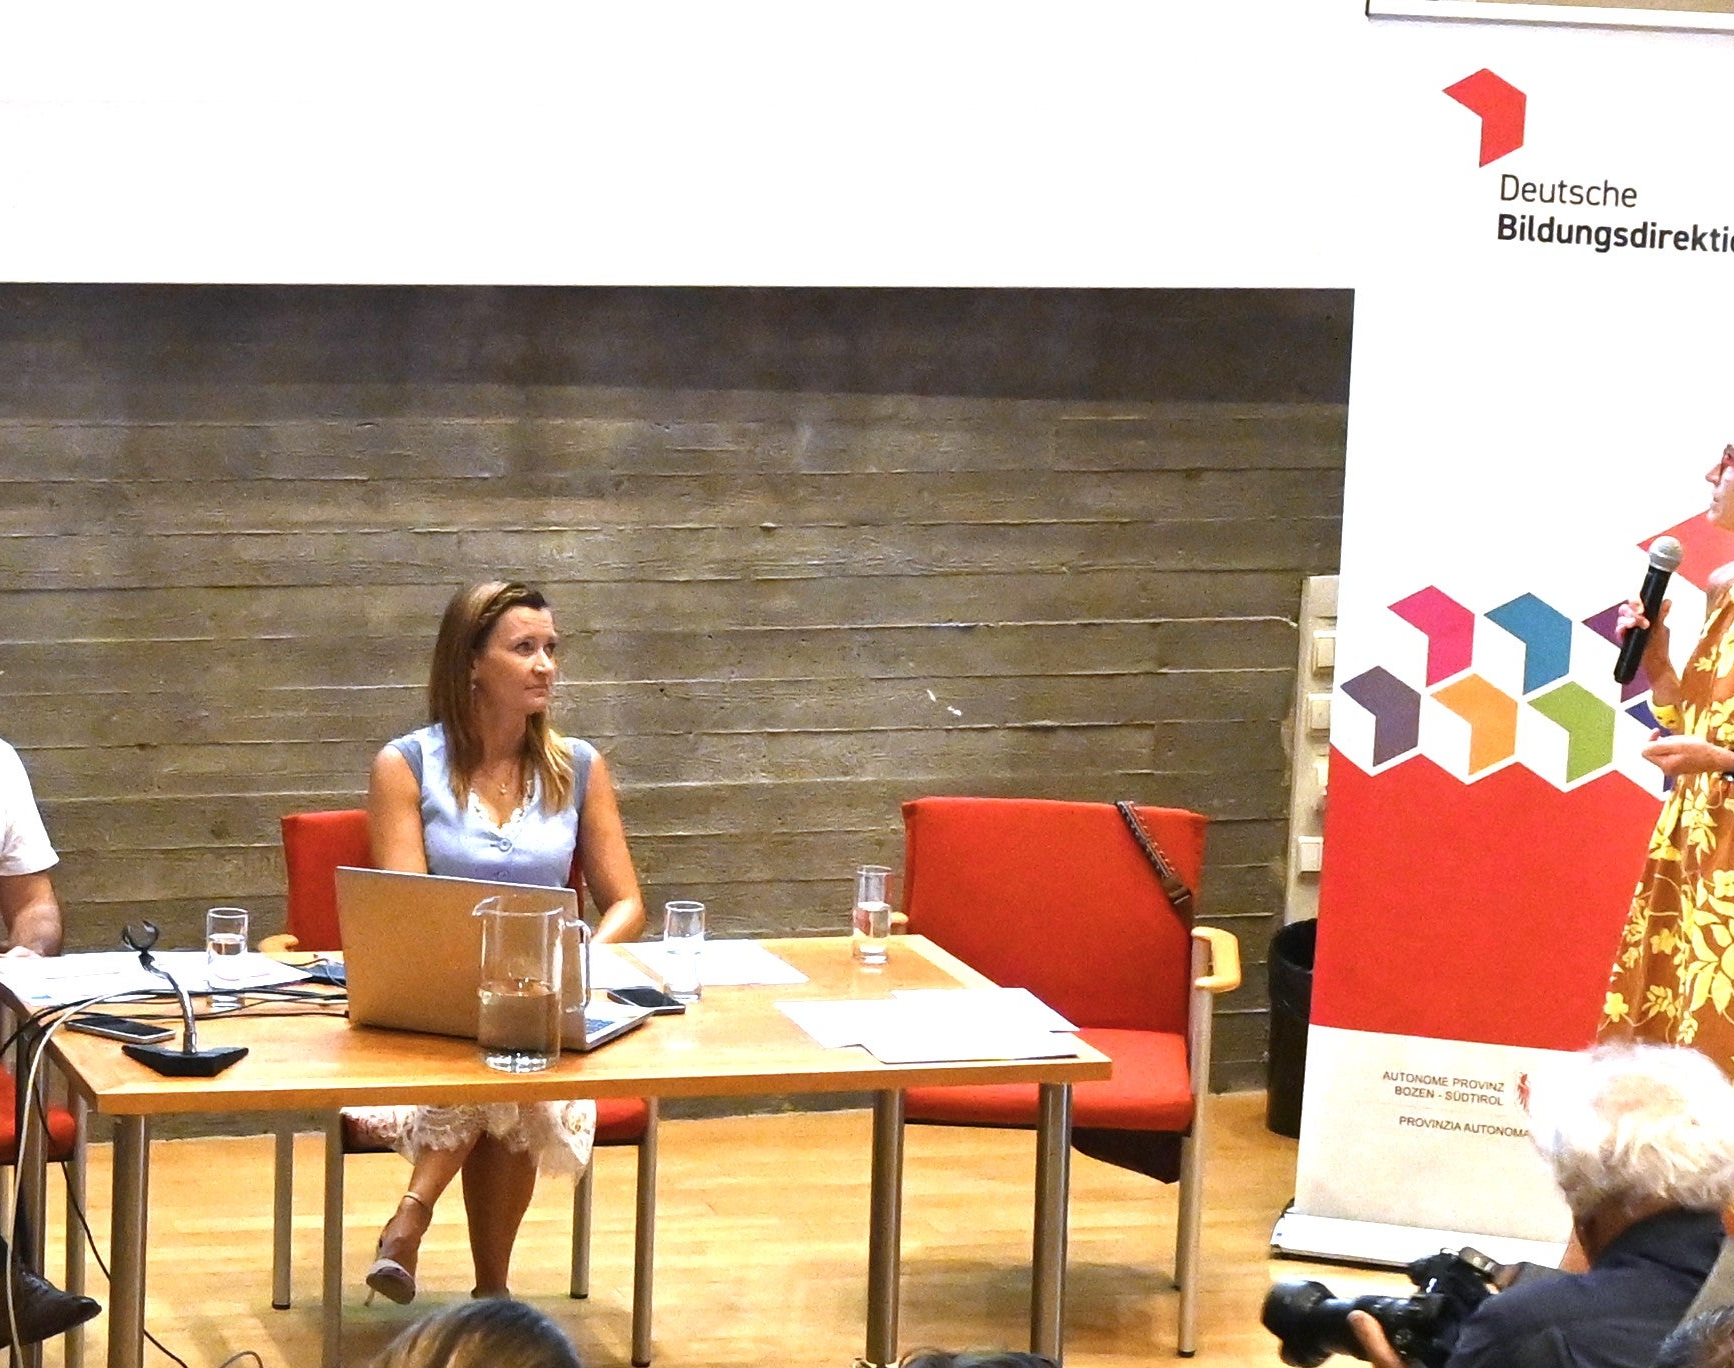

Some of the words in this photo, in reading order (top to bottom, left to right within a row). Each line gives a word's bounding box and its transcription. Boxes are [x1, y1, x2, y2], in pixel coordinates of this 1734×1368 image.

[1499, 173, 1638, 209] Deutsche
[1382, 1070, 1449, 1088] AUTONOME
[1452, 1077, 1505, 1093] PROVINZ
[1394, 1085, 1435, 1099] BOZEN
[1445, 1087, 1504, 1106] SÜDTIROL
[1399, 1116, 1462, 1132] PROVINZIA
